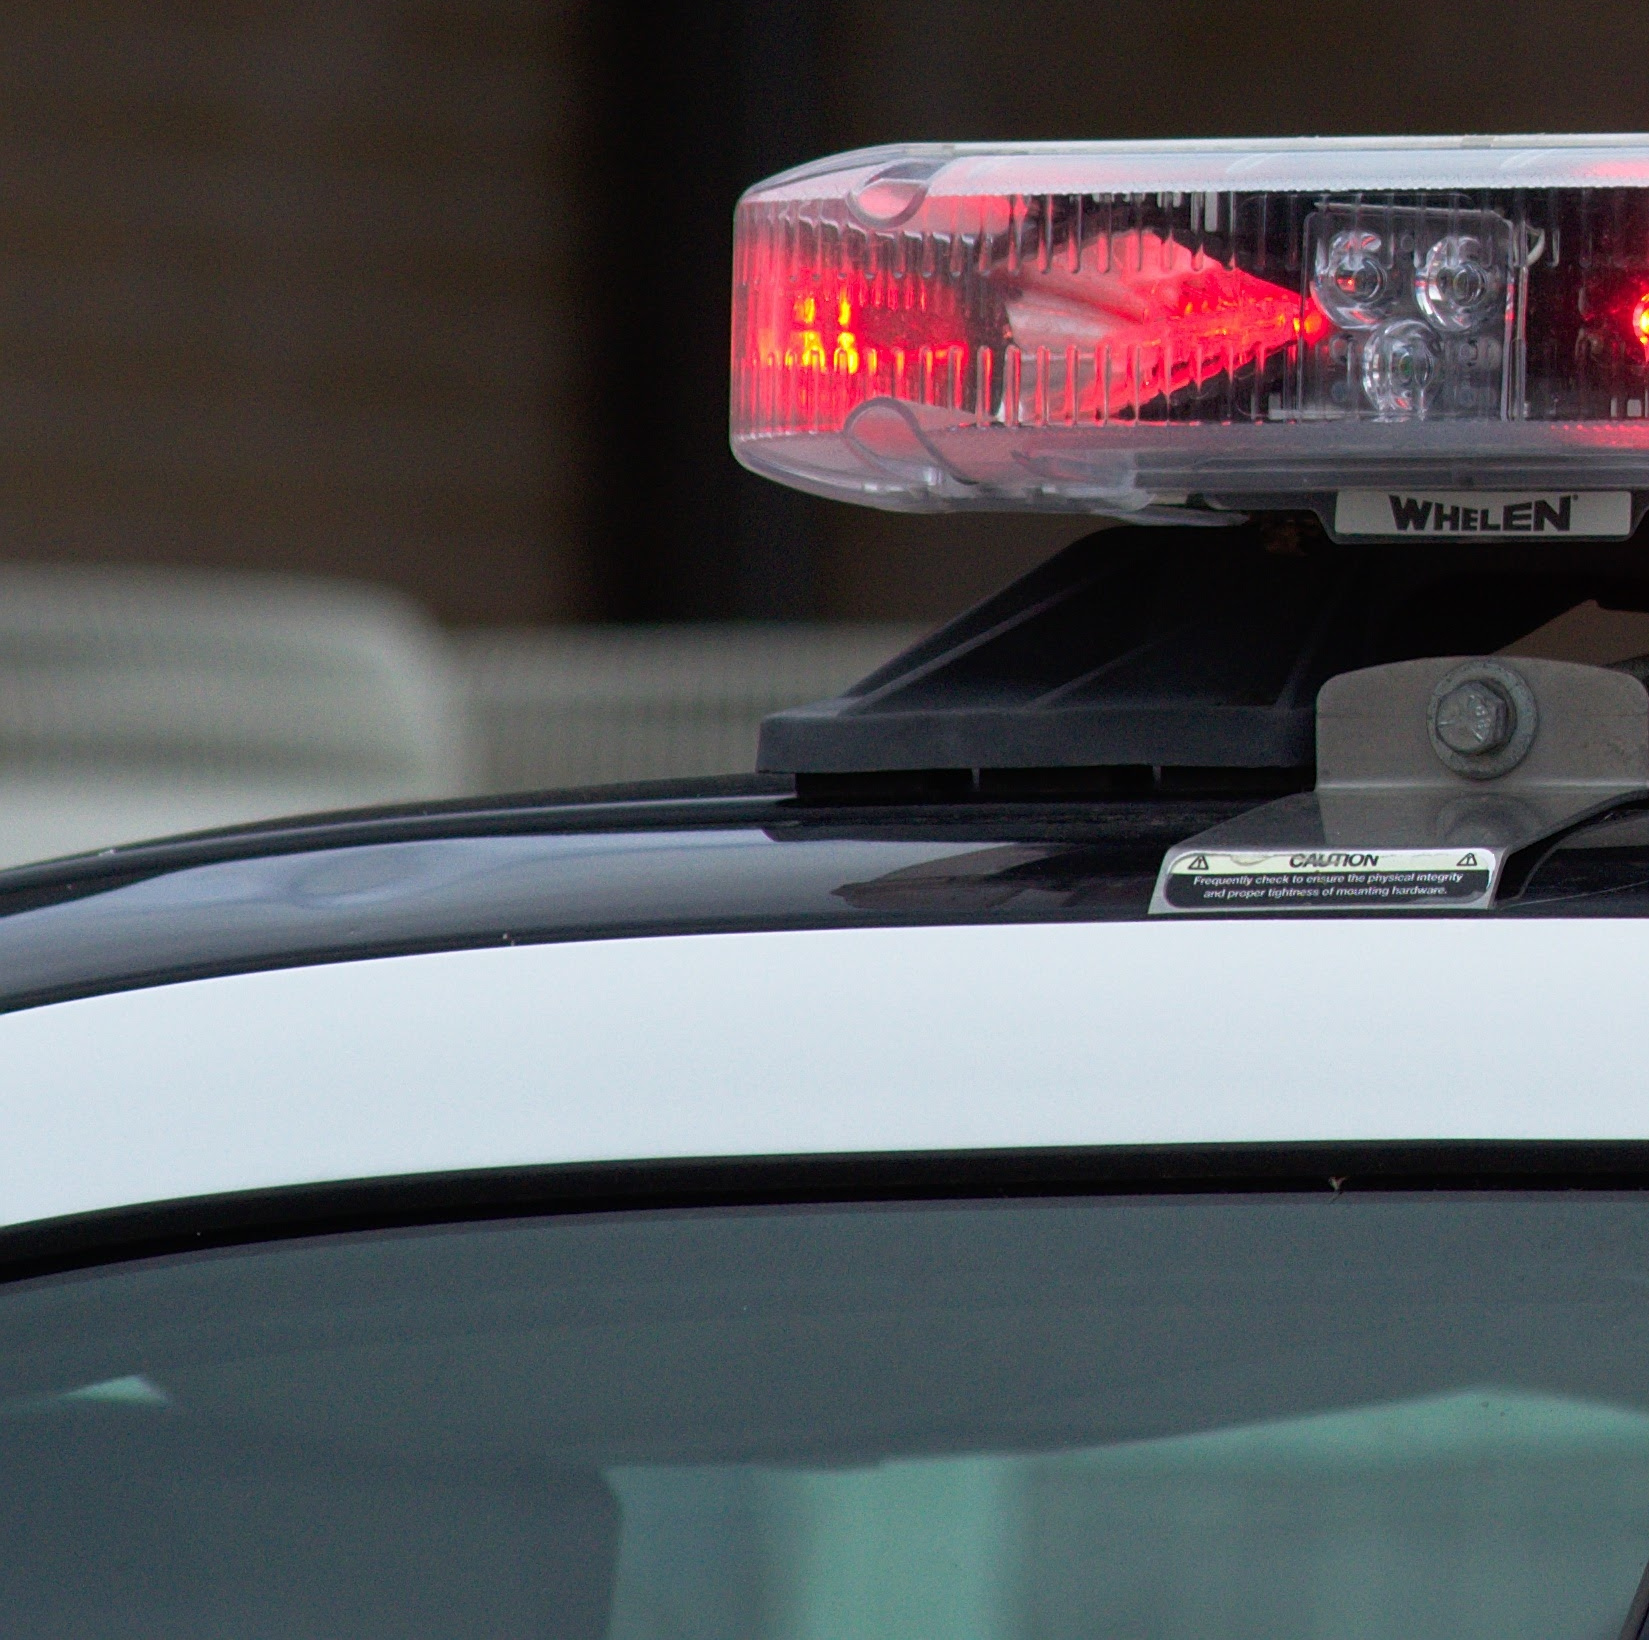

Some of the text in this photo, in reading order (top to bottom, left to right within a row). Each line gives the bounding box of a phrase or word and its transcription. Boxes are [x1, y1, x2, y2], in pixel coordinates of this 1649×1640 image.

[1389, 494, 1571, 532] WHELEN
[1289, 853, 1379, 867] CAUTION
[1193, 873, 1464, 886] Frequently check to ensure the physical integrity
[1203, 885, 1447, 899] and proper tightness of mounting hardware.
